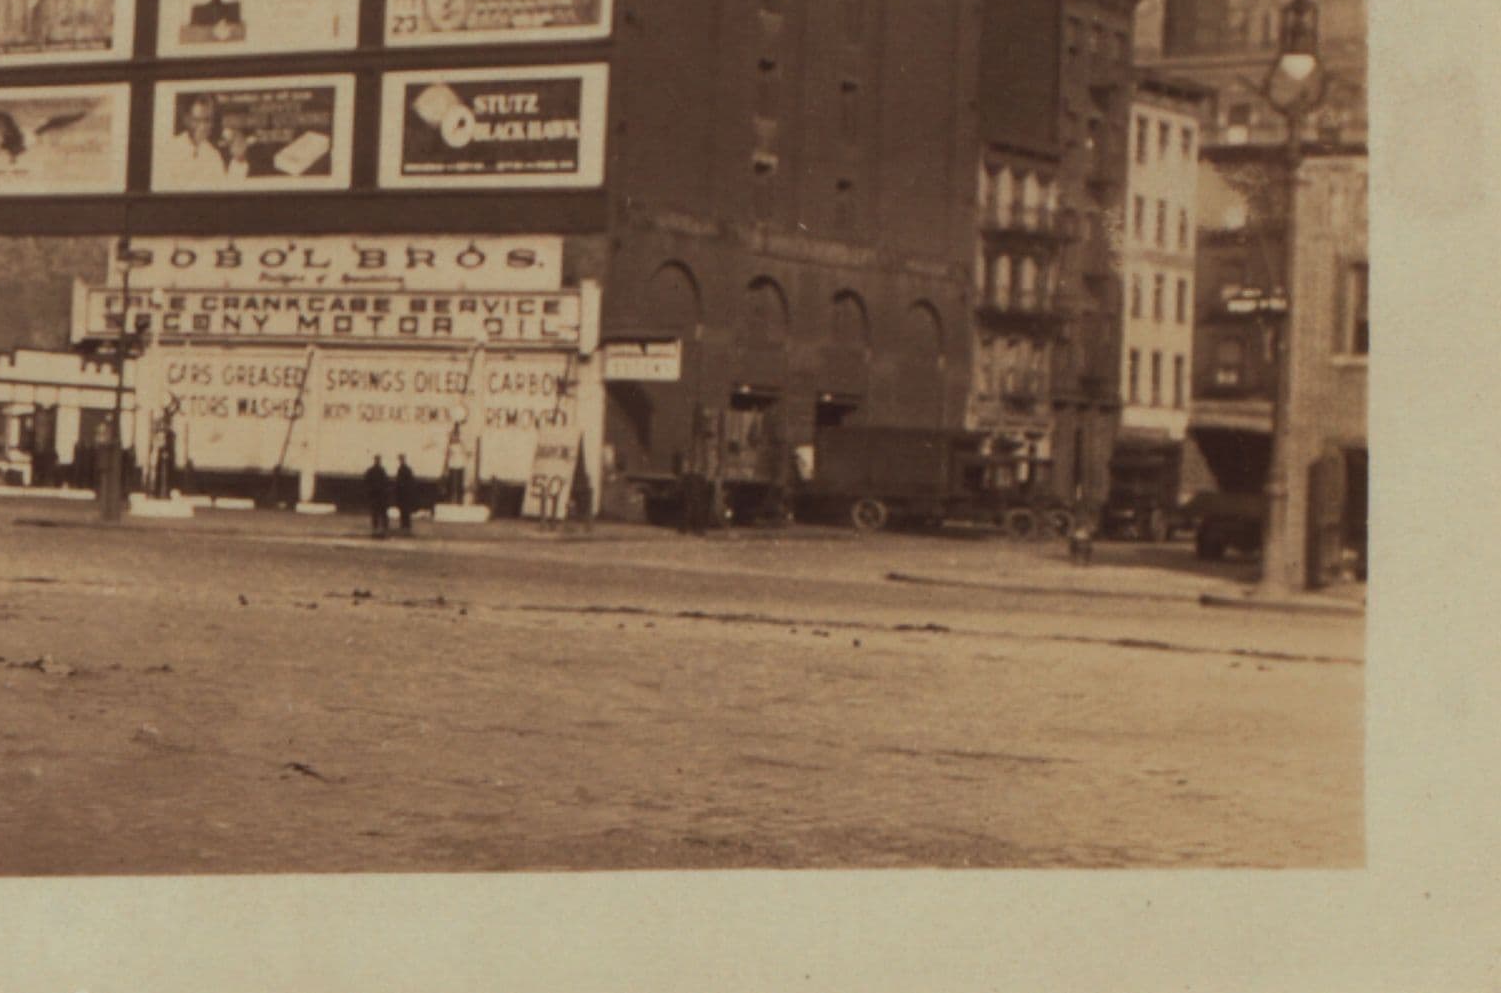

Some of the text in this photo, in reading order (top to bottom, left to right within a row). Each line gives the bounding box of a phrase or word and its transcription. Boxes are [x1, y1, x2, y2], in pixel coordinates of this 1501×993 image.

[473, 93, 538, 115] STUTZ
[471, 119, 580, 142] BLACK HAWK
[115, 247, 332, 270] SOBOL
[200, 296, 392, 314] CRANKCASE
[409, 298, 561, 315] SERVICE
[297, 314, 452, 335] MOTOR
[482, 317, 561, 337] OIL
[166, 363, 212, 386] CARS
[326, 368, 406, 392] SPRINGS
[236, 397, 305, 420] WASHED
